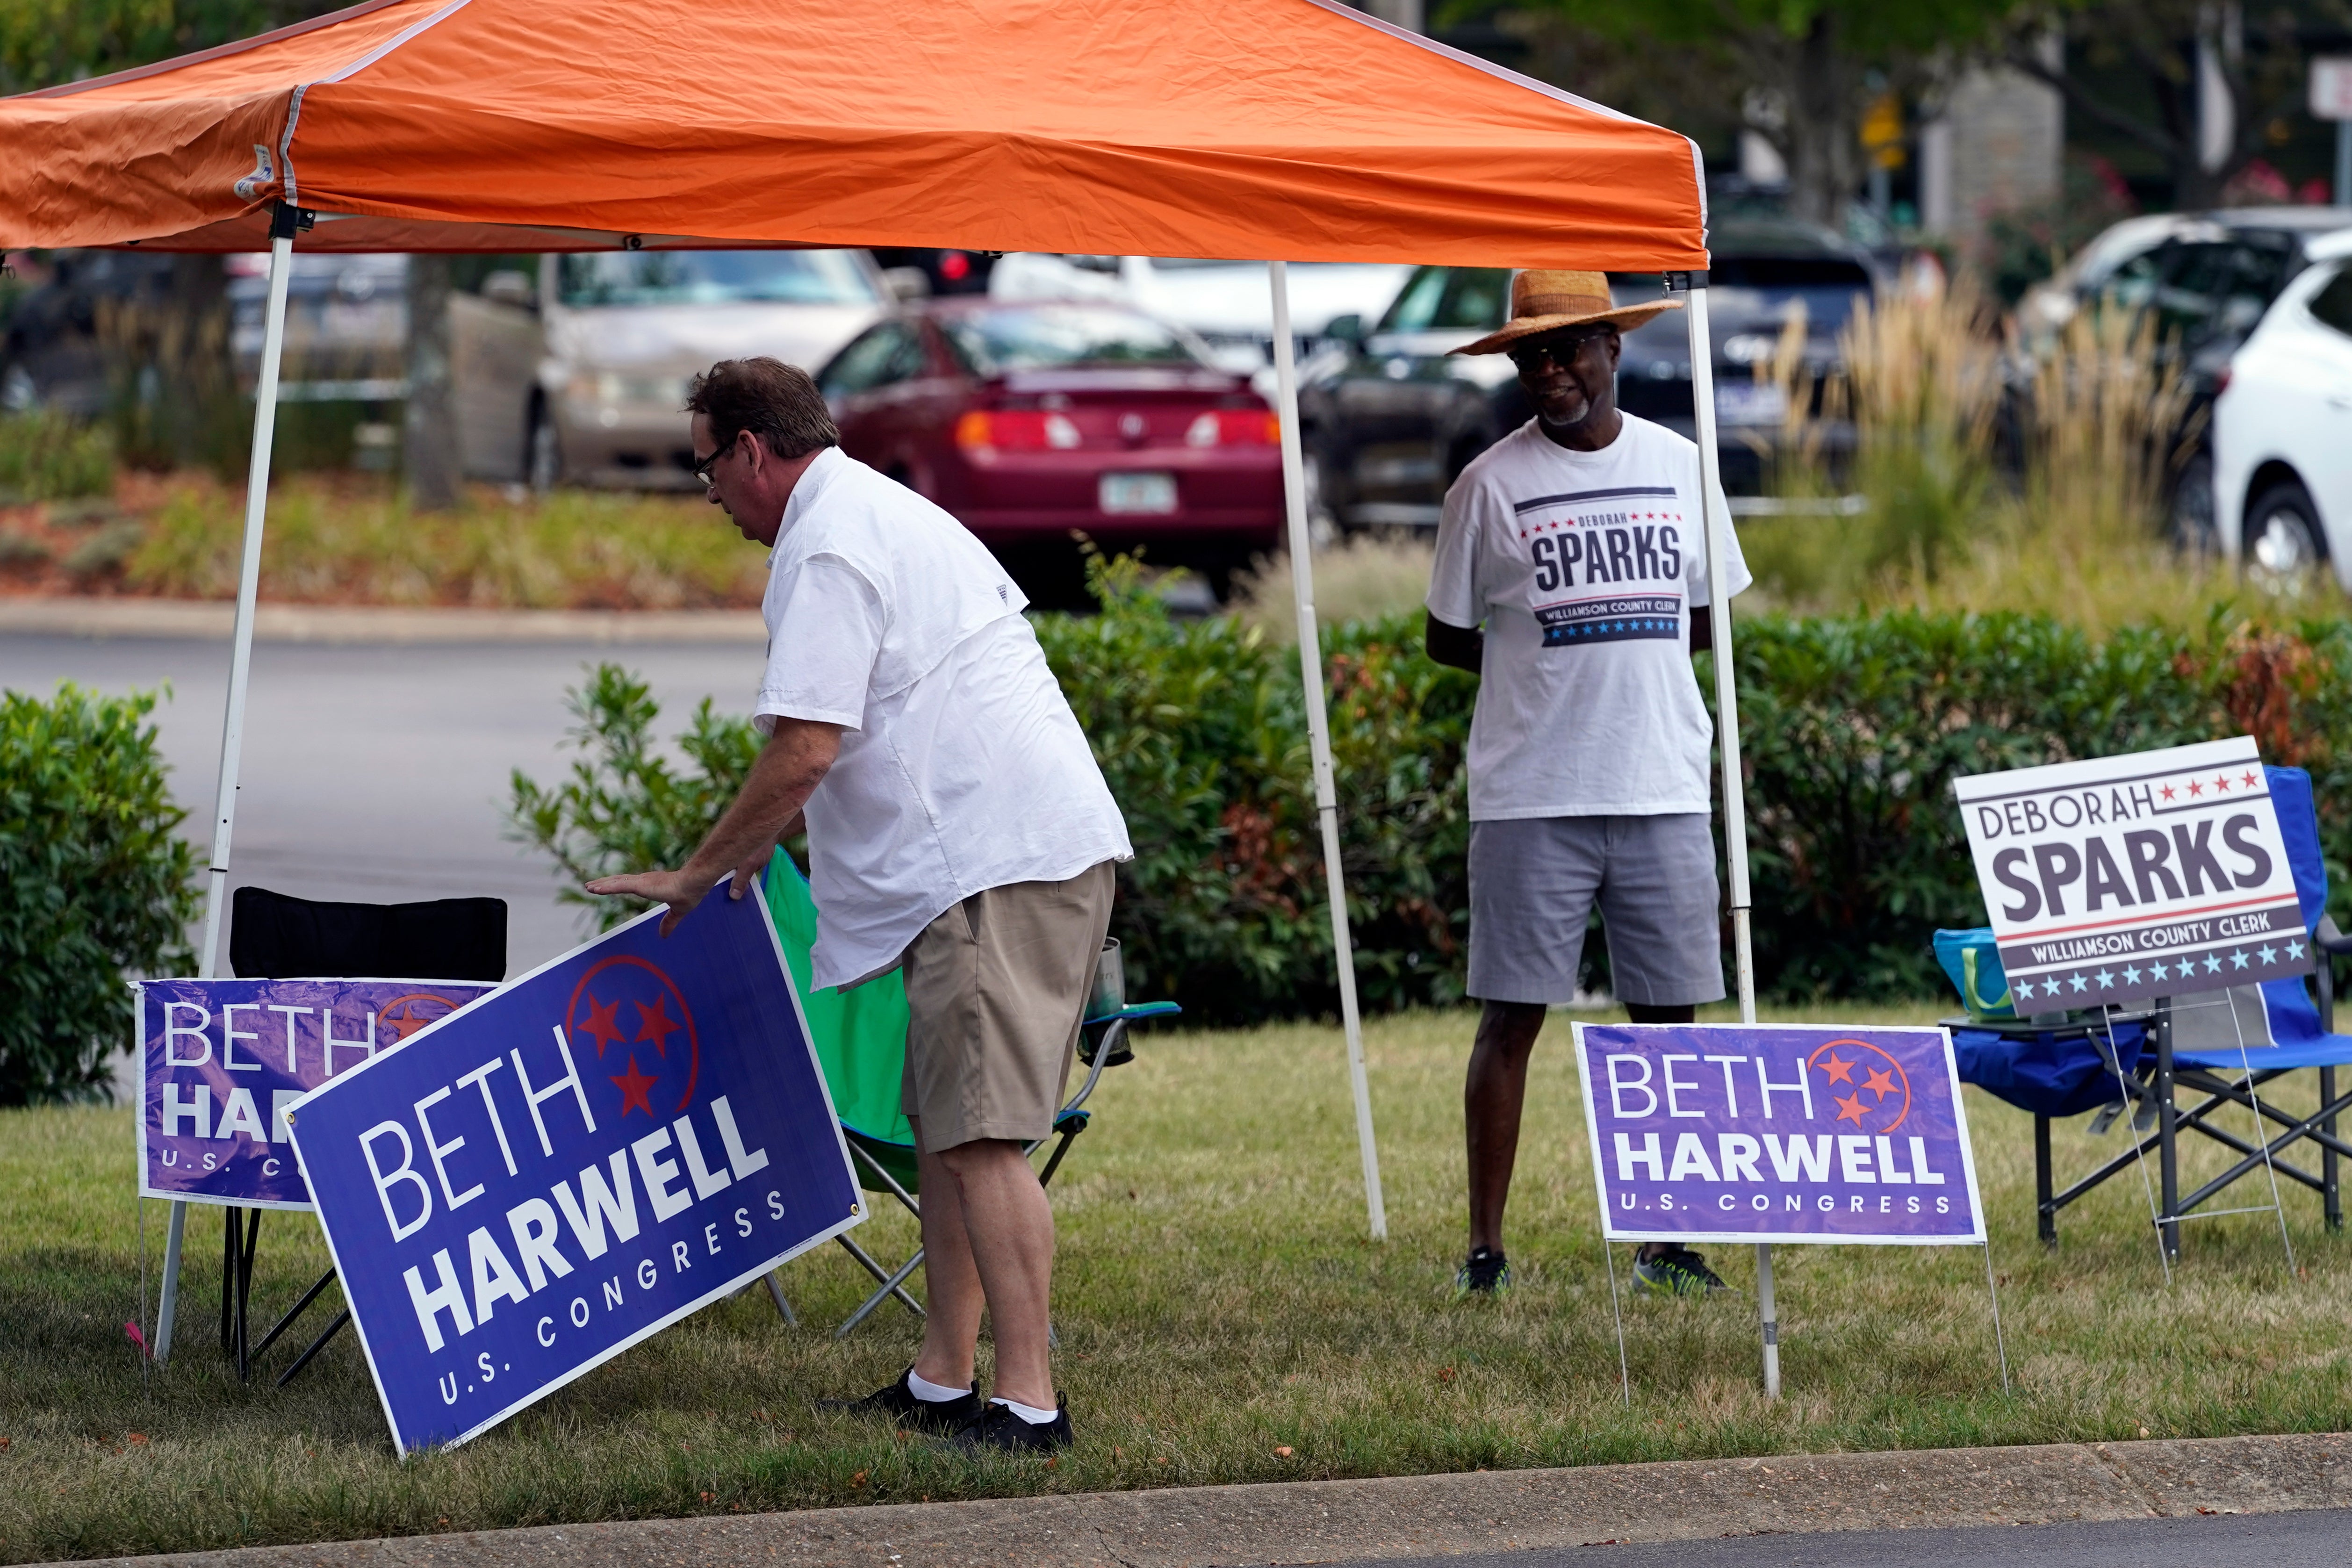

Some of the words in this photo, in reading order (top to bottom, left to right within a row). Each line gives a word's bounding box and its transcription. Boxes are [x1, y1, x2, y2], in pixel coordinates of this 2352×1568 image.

[1578, 513, 1627, 527] DEBORAH
[1532, 525, 1681, 591] SPARKS
[1545, 603, 1608, 620] WILLIAMSON
[1611, 600, 1652, 613] COUNTY
[1654, 600, 1677, 612] CLERK
[1978, 784, 2156, 840] DEBORAH
[1992, 814, 2273, 922] SPARKS
[2031, 933, 2135, 964] WILLIAMSON
[2139, 921, 2211, 948] COUNTY
[2219, 912, 2271, 936] CLERK
[164, 1001, 375, 1077] BETH
[1606, 1054, 1814, 1120] BETH
[162, 1149, 230, 1172] U.S.
[358, 1024, 597, 1243] BETH
[1613, 1133, 1945, 1184] HARWELL
[403, 1095, 769, 1354] HARWELL
[1621, 1193, 1688, 1211] U.S.
[1719, 1194, 1949, 1214] CONGRESS
[439, 1352, 511, 1405] U.S.
[537, 1191, 784, 1347] CONGRESS
